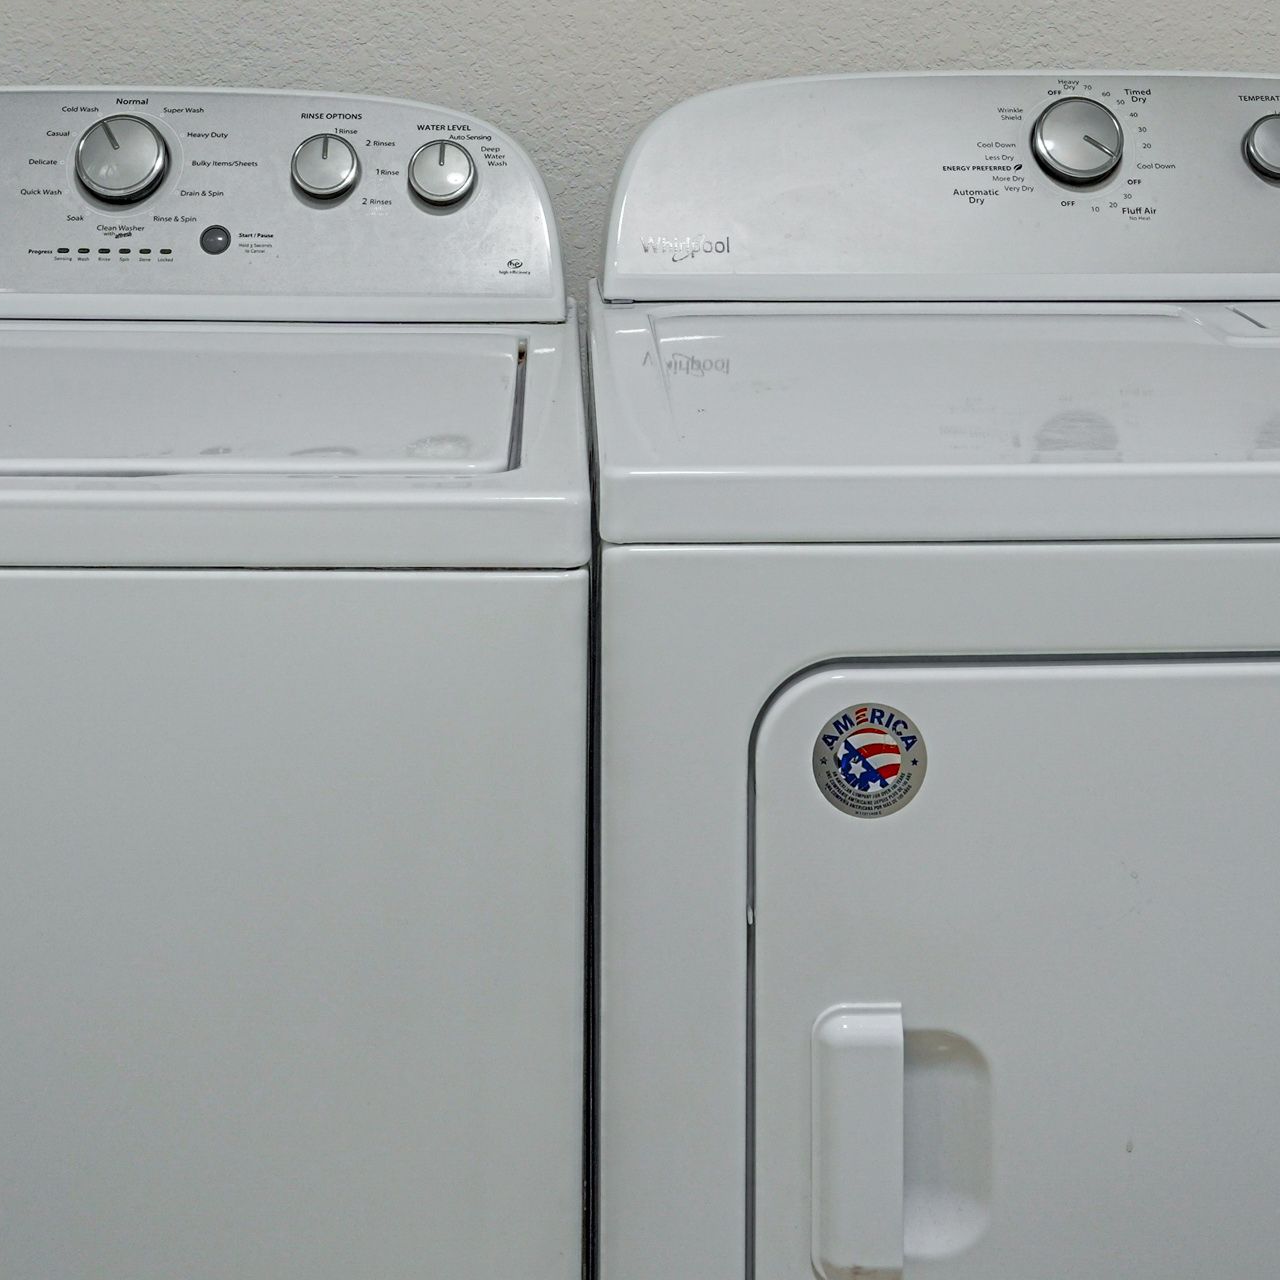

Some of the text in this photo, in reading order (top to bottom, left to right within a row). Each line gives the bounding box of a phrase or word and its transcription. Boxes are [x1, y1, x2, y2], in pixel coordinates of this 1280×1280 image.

[1124, 88, 1151, 96] Timed
[208, 190, 224, 198] Spin
[969, 197, 985, 205] Dry
[640, 236, 730, 258] Whirlpool
[821, 707, 918, 752] AMERICA
